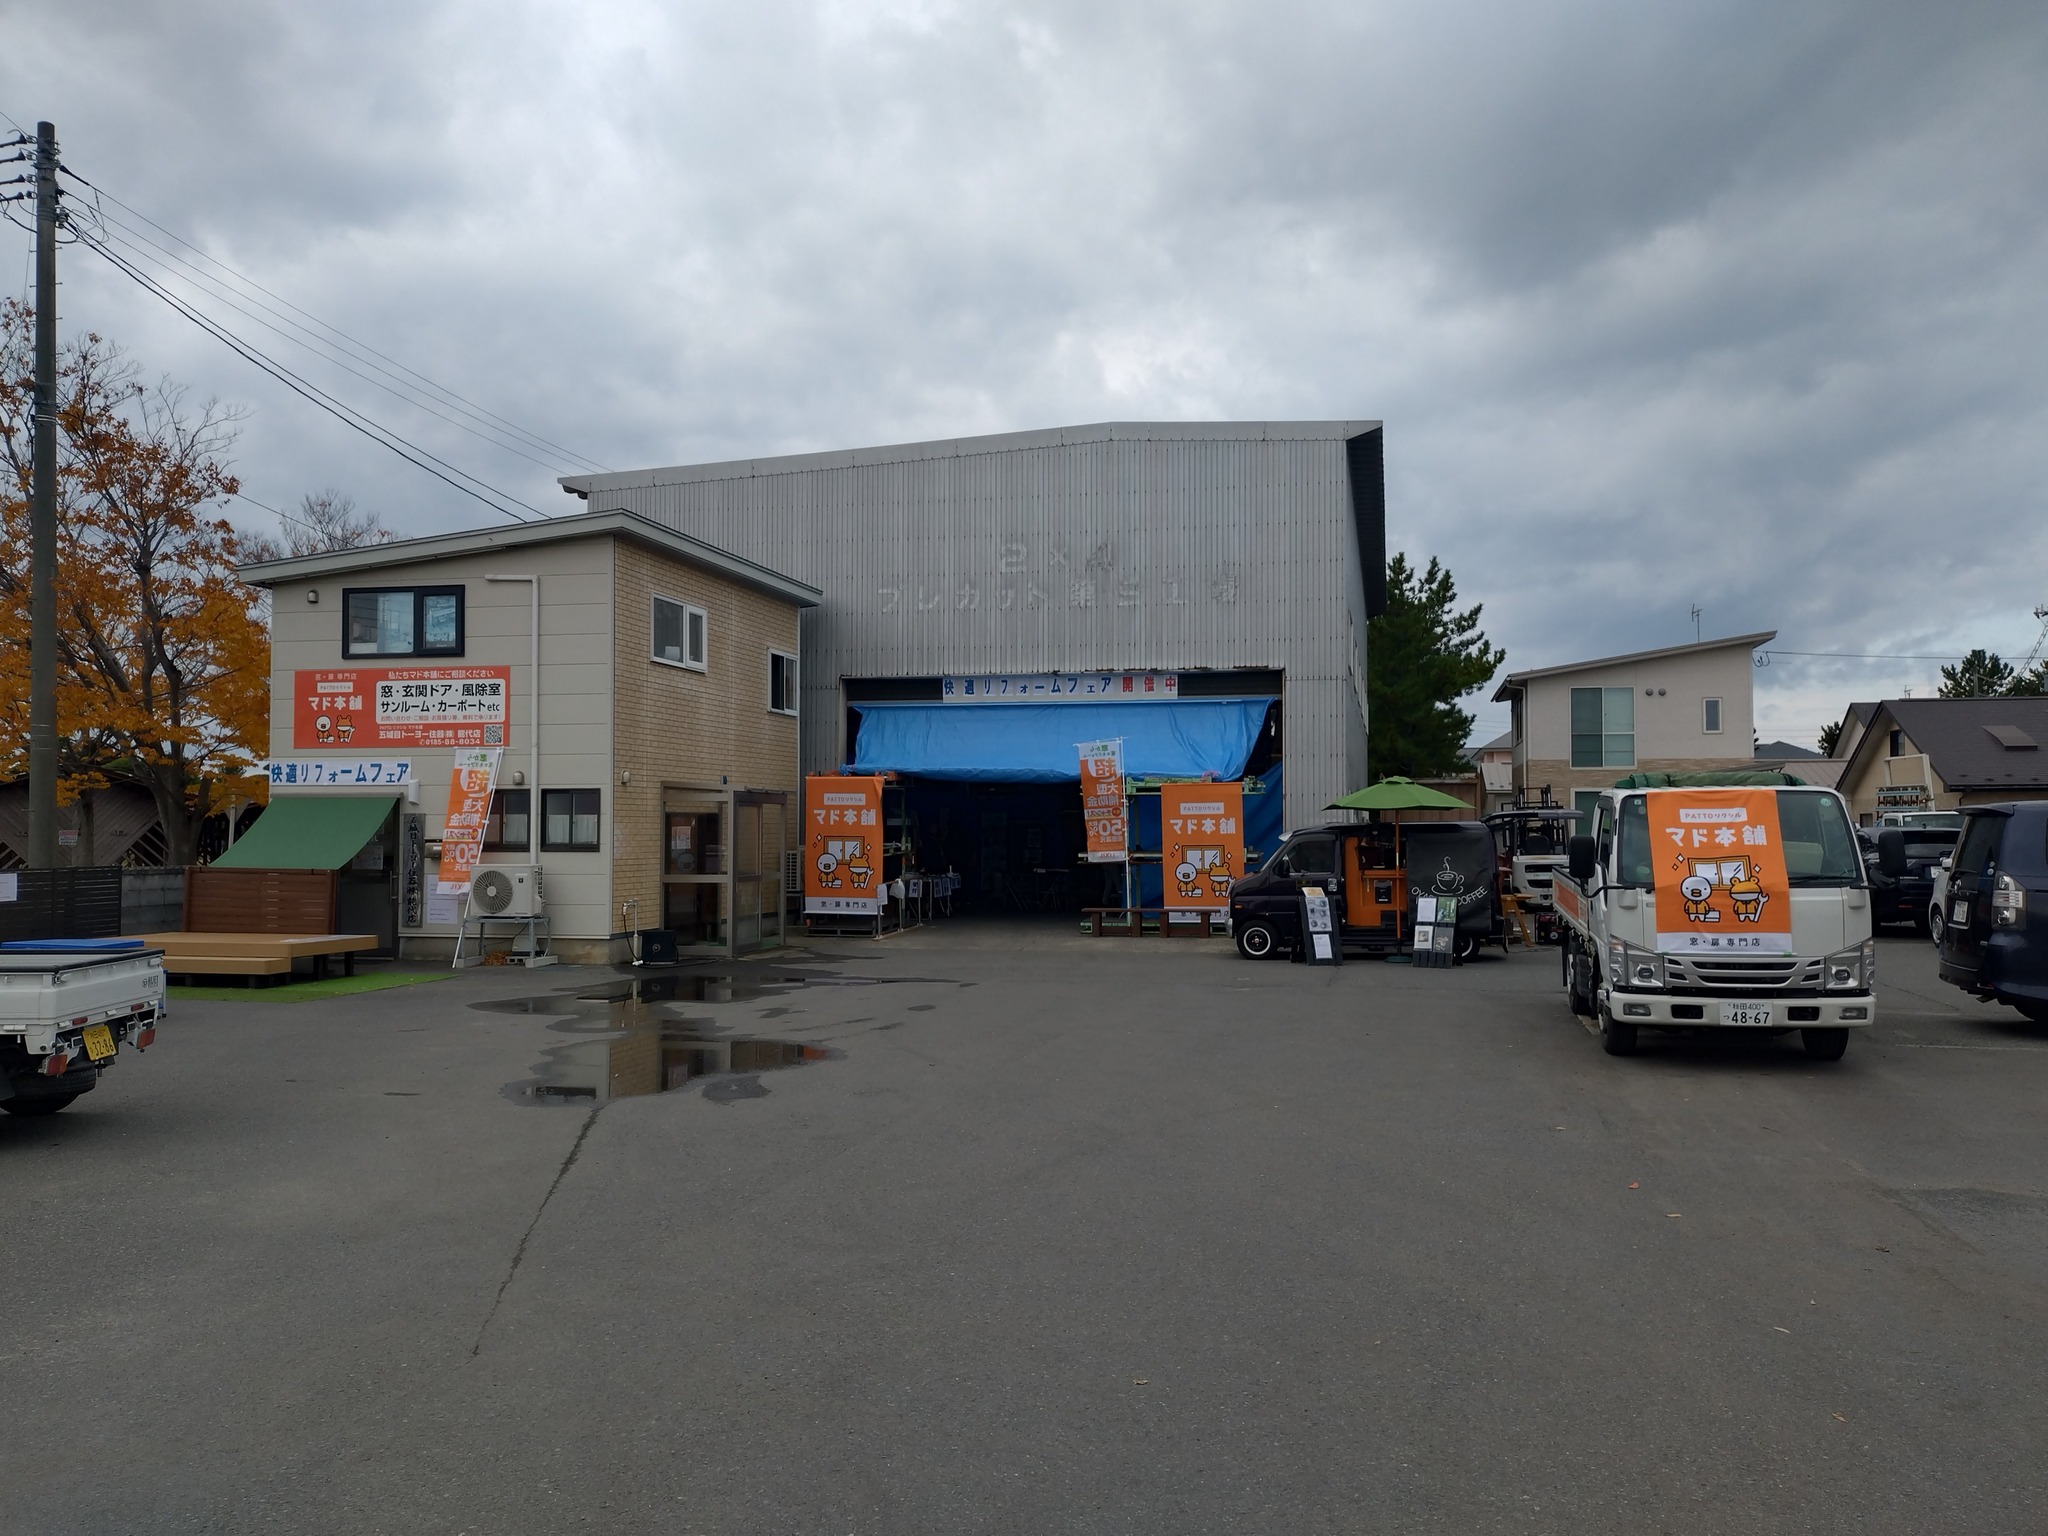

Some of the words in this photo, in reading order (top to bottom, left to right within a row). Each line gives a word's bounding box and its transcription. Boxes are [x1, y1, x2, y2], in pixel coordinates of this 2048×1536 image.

[388, 670, 494, 680] 私たちマド本舗にご相談ください
[380, 683, 501, 698] 窓・玄関ドア・風除室
[308, 695, 363, 711] マド本舗
[271, 763, 409, 783] 快適リフォームフェア
[813, 809, 876, 825] マド本舗
[1170, 817, 1236, 834] マド本舗
[1665, 825, 1767, 848] マド本舗
[1727, 937, 1761, 947] 専門店
[1732, 1011, 1770, 1024] 48-67
